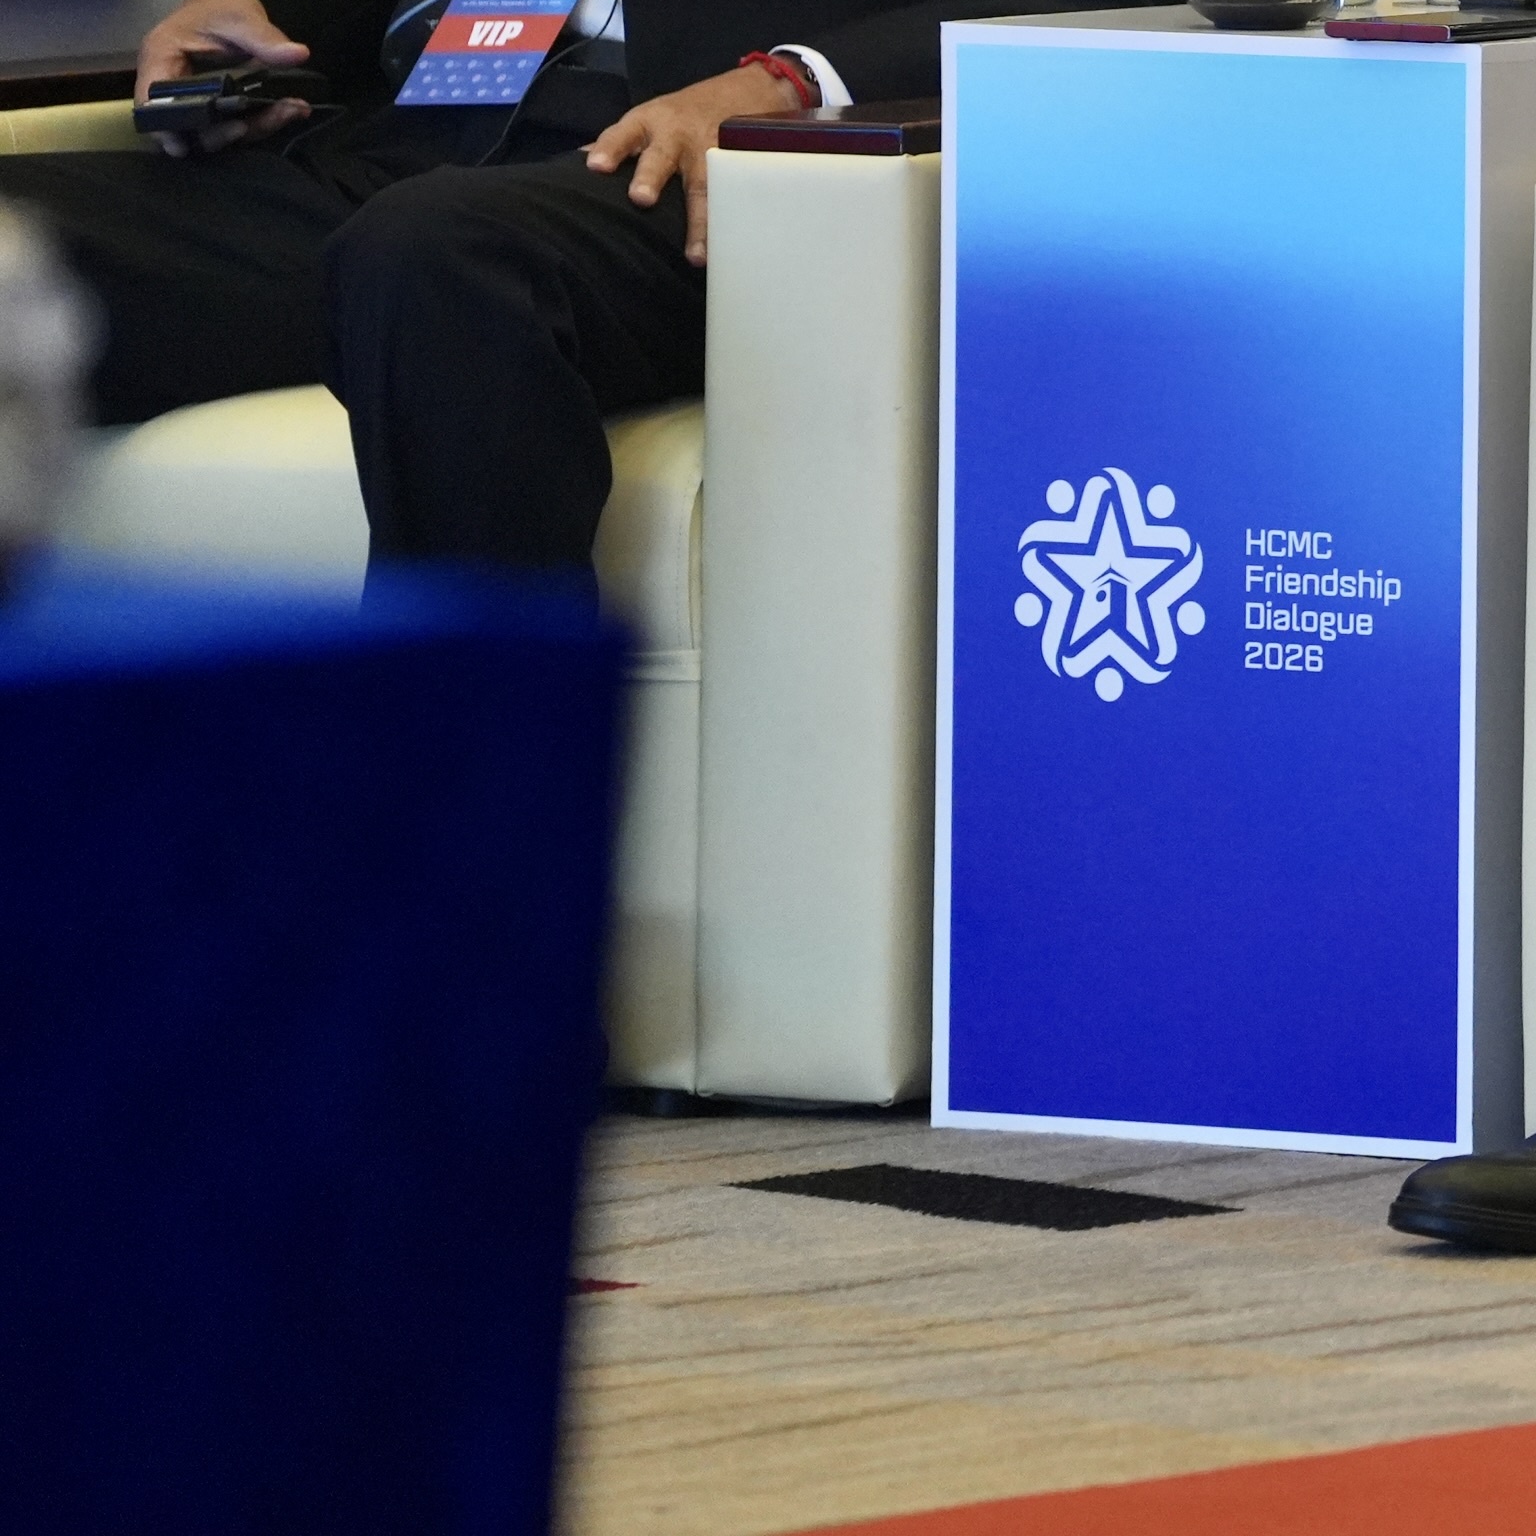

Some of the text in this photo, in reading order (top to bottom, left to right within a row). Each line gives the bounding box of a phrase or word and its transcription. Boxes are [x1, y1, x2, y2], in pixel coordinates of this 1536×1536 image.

[467, 20, 524, 47] VIP
[1245, 528, 1333, 560] HCMC
[1245, 564, 1402, 606] Friendship
[1245, 601, 1373, 641] Dialogue
[1244, 642, 1324, 672] 2026
